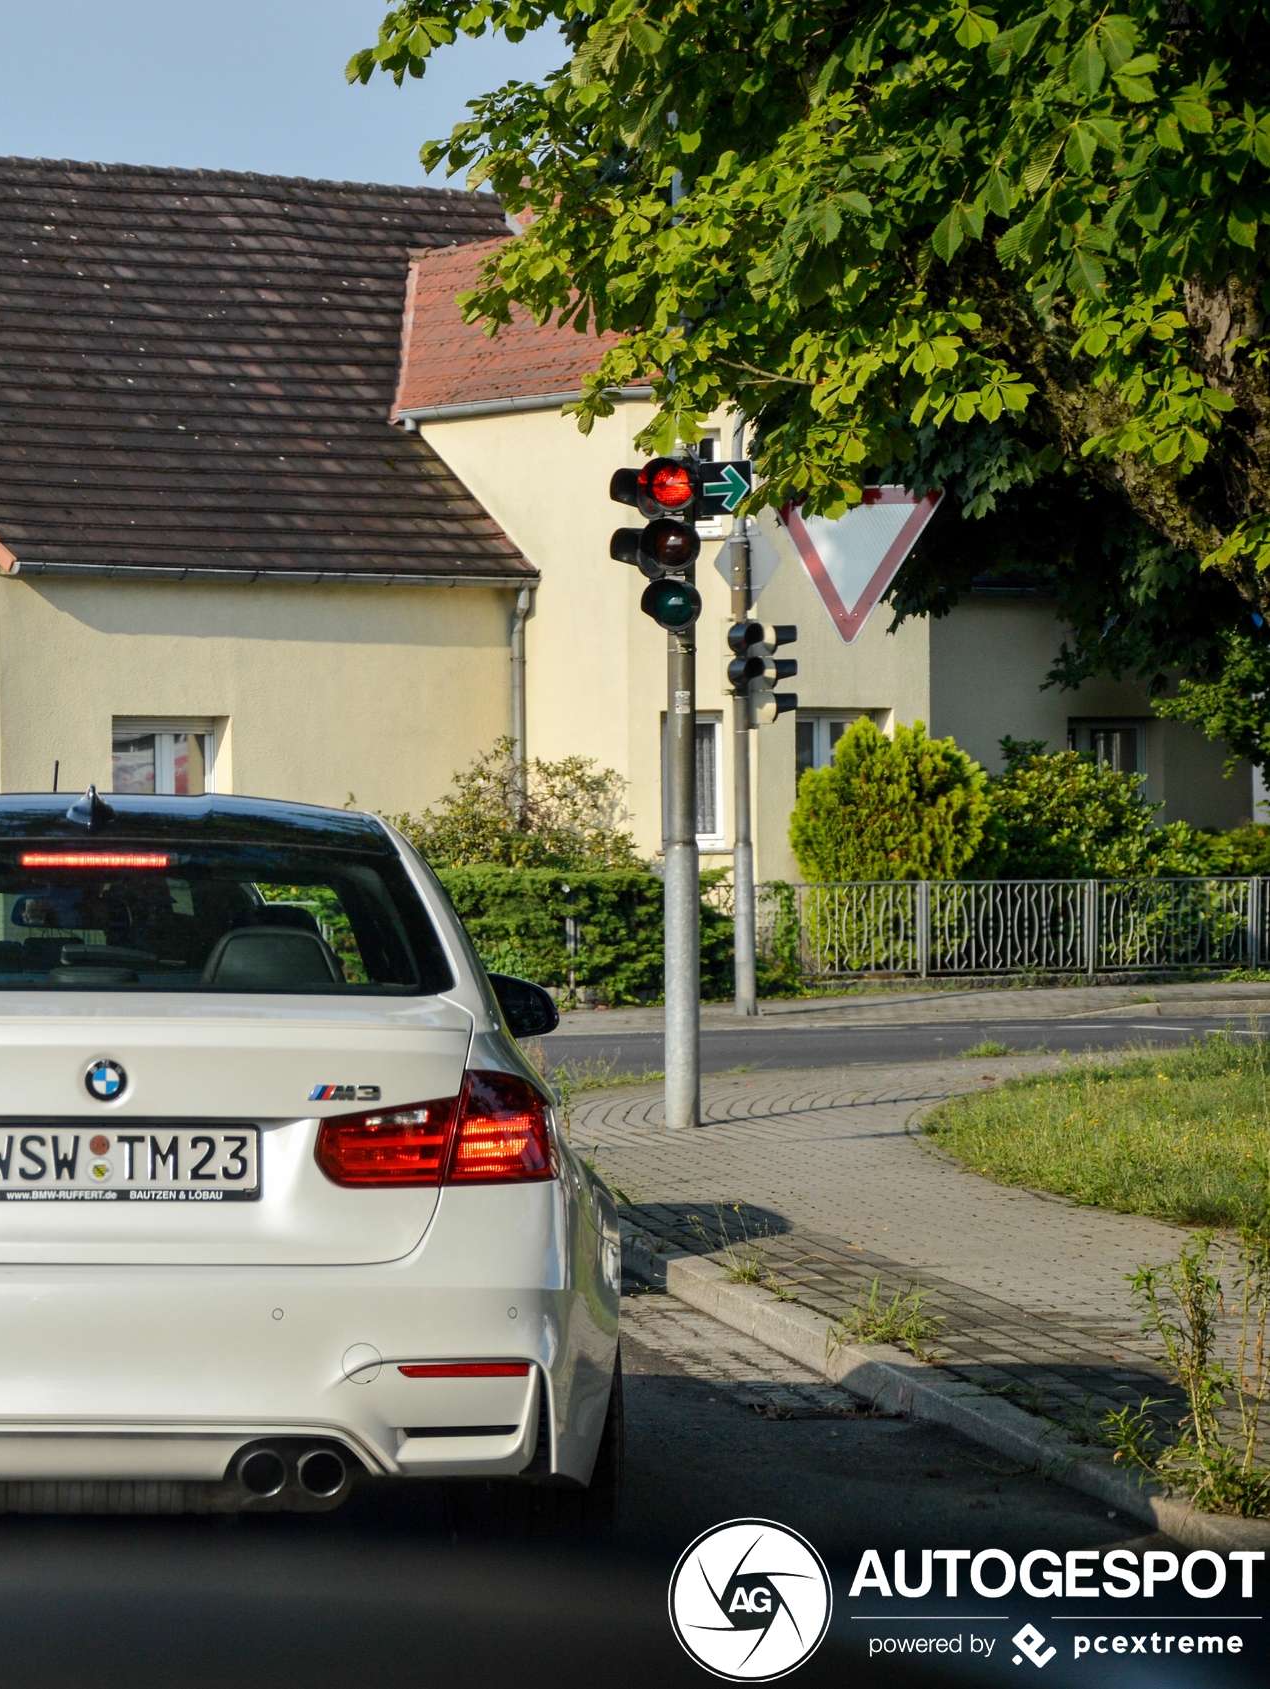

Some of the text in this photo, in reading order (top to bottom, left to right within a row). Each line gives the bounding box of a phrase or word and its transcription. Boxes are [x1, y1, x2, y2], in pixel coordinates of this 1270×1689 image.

[328, 1084, 381, 1101] M3
[6, 1188, 223, 1200] www.BMW-RUFFERT.de BAUTZEN & LÖBAU
